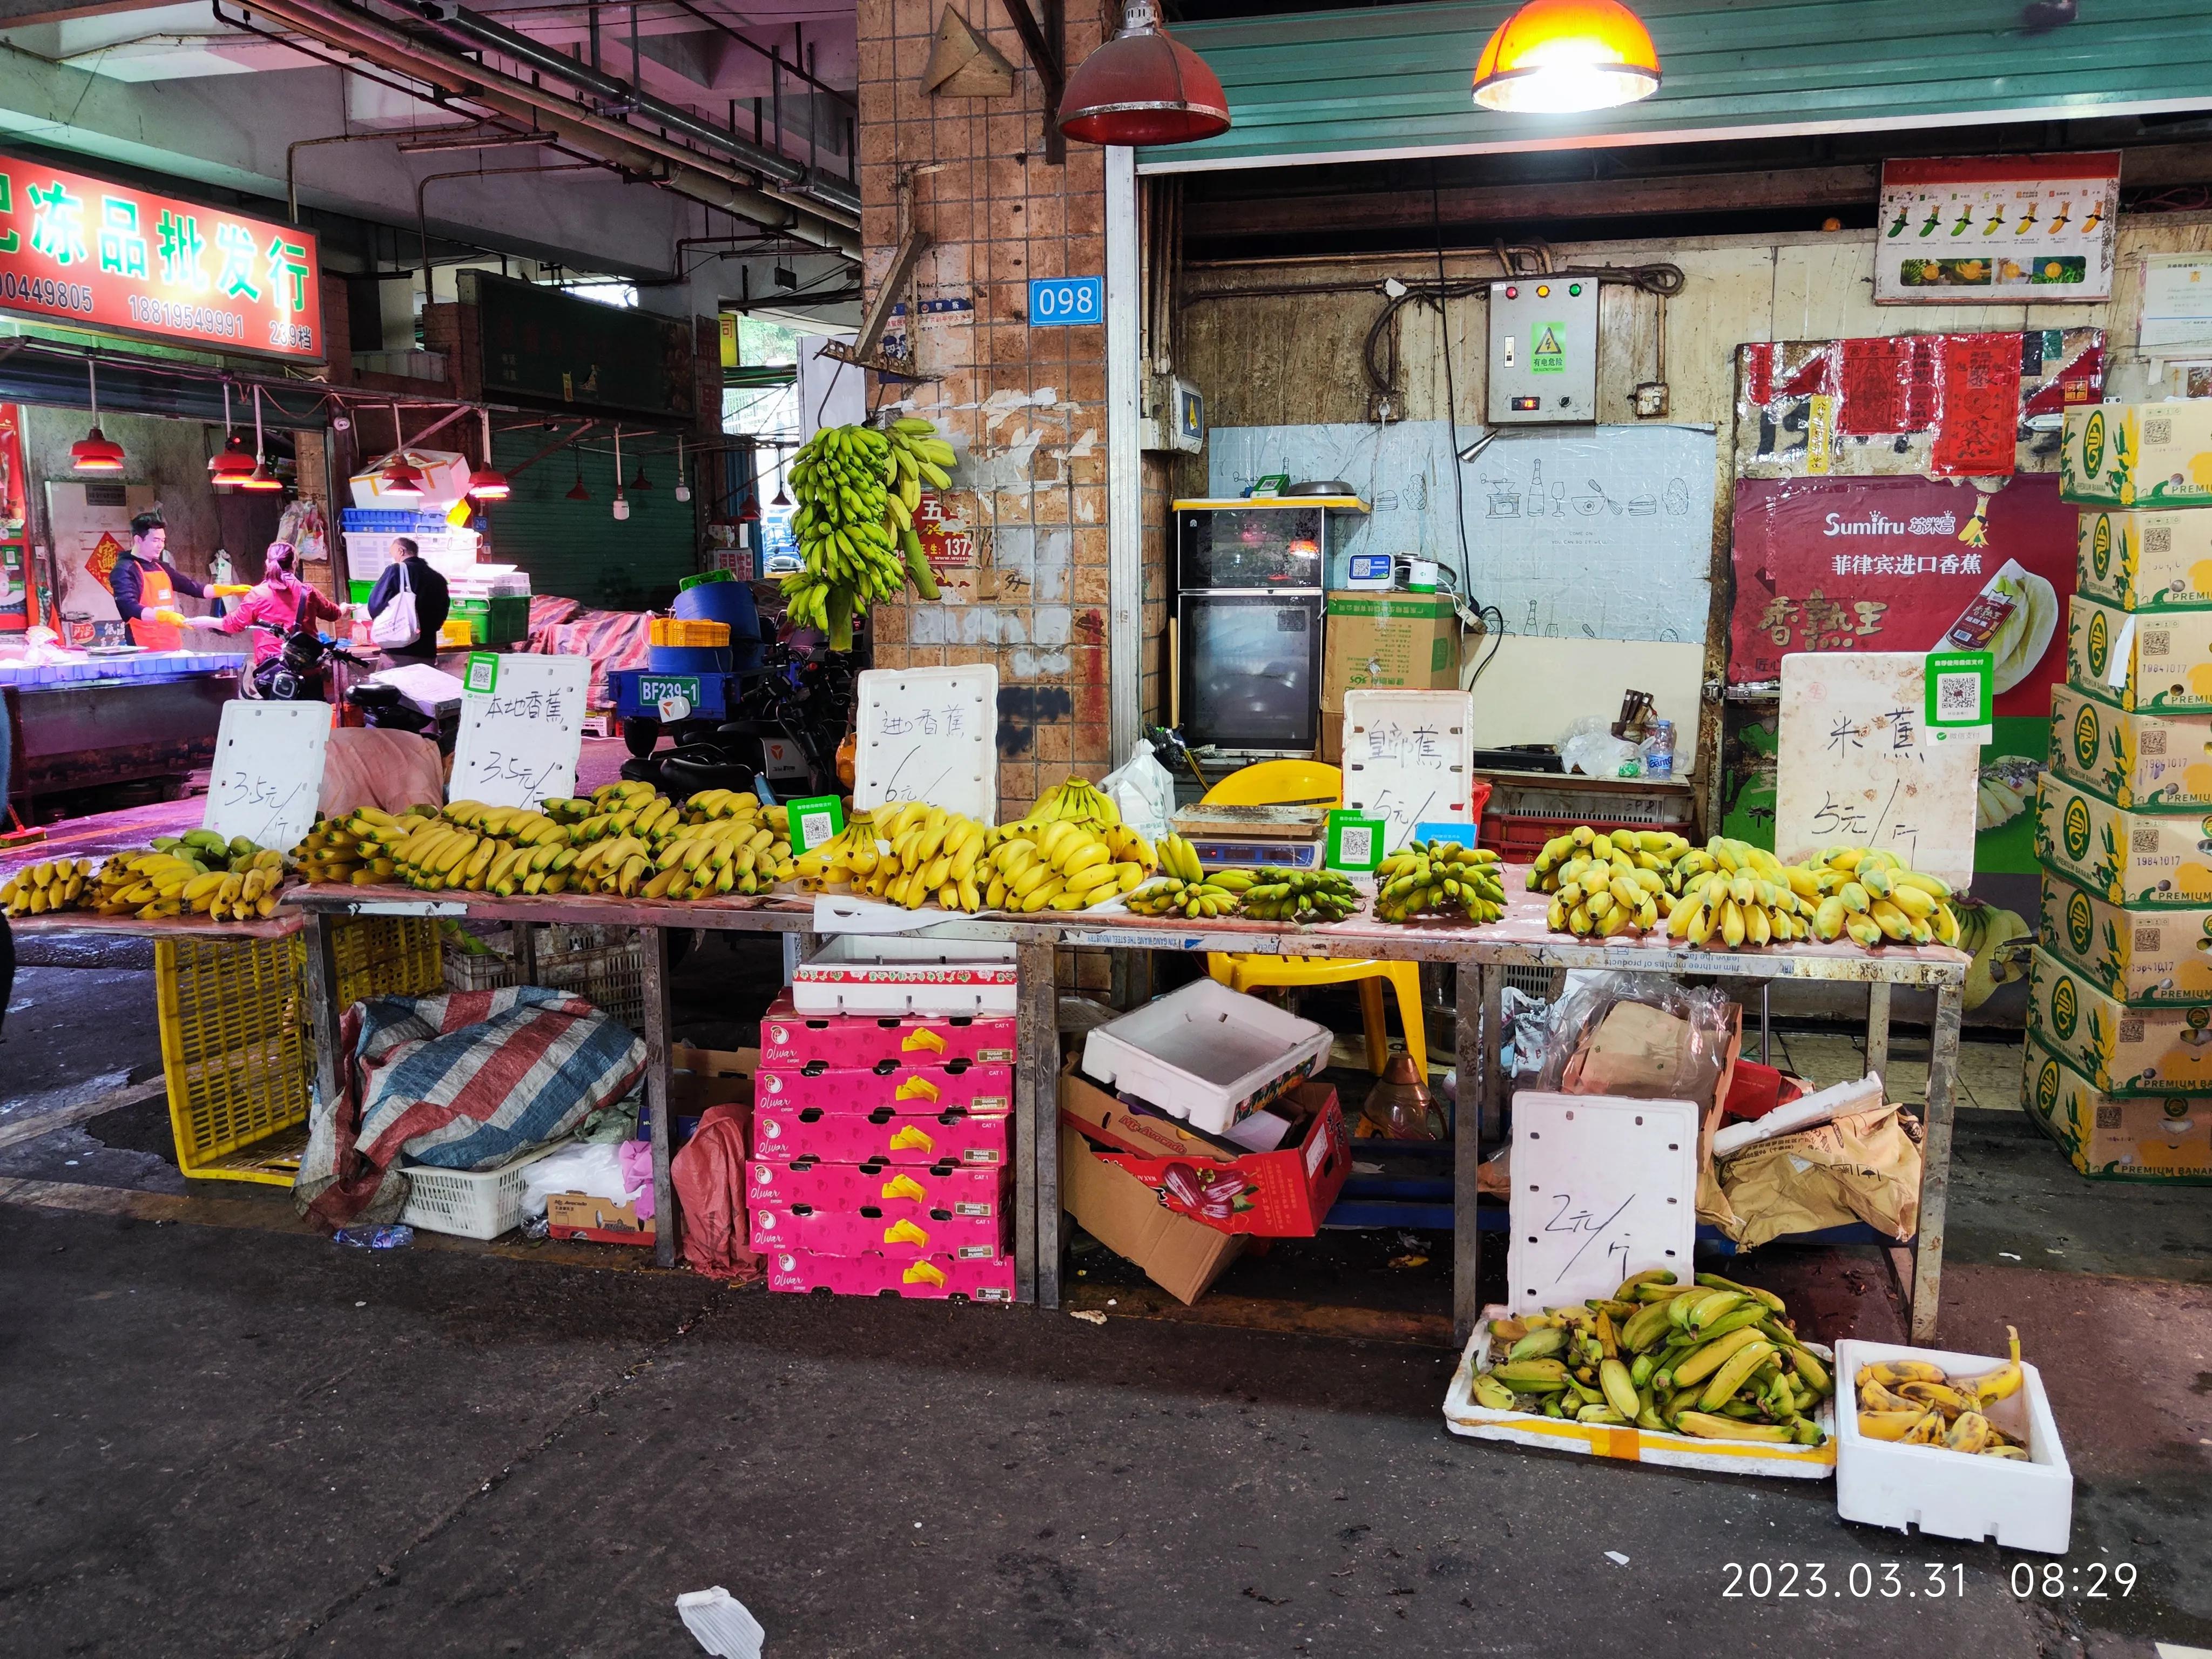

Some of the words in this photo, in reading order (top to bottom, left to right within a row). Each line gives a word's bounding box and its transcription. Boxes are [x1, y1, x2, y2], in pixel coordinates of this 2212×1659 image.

[1040, 286, 1092, 315] 098
[0, 272, 92, 312] 0449805
[129, 296, 244, 339] 18819549991
[270, 321, 313, 350] 239档
[1533, 358, 1563, 367] 有电危险
[922, 500, 943, 520] 五
[476, 520, 487, 529] 240
[1823, 510, 1904, 536] Sumifru
[1831, 554, 1982, 575] 菲律宾进口香蕉
[1757, 588, 1888, 651] 香熟王
[643, 682, 697, 701] BF239-1
[485, 687, 563, 724] 本地香蕉
[880, 704, 965, 739] 进口香蕉
[1827, 706, 1924, 764] 米蕉
[1949, 731, 1980, 740] 微信支付
[1368, 720, 1442, 770] 皇帝蕉
[2136, 855, 2181, 866] 19841017
[2159, 892, 2211, 900] PREMIUM
[1088, 934, 1112, 943] INDUSTRY
[1112, 935, 1127, 944] STEEL
[1127, 935, 1137, 944] THE
[1604, 959, 1642, 968] products
[1655, 962, 1687, 970] months
[1723, 963, 1740, 972] film
[766, 1044, 798, 1061] Olivar
[2144, 1080, 2196, 1088] PREMIUM
[760, 1093, 791, 1109] Olivar
[759, 1138, 789, 1155] Olivar
[1139, 1126, 1188, 1155] Avocado
[2121, 1165, 2174, 1176] PREMIUM
[750, 1184, 780, 1200] Olivar
[754, 1229, 784, 1245] Olivar
[774, 1271, 804, 1286] Olivar
